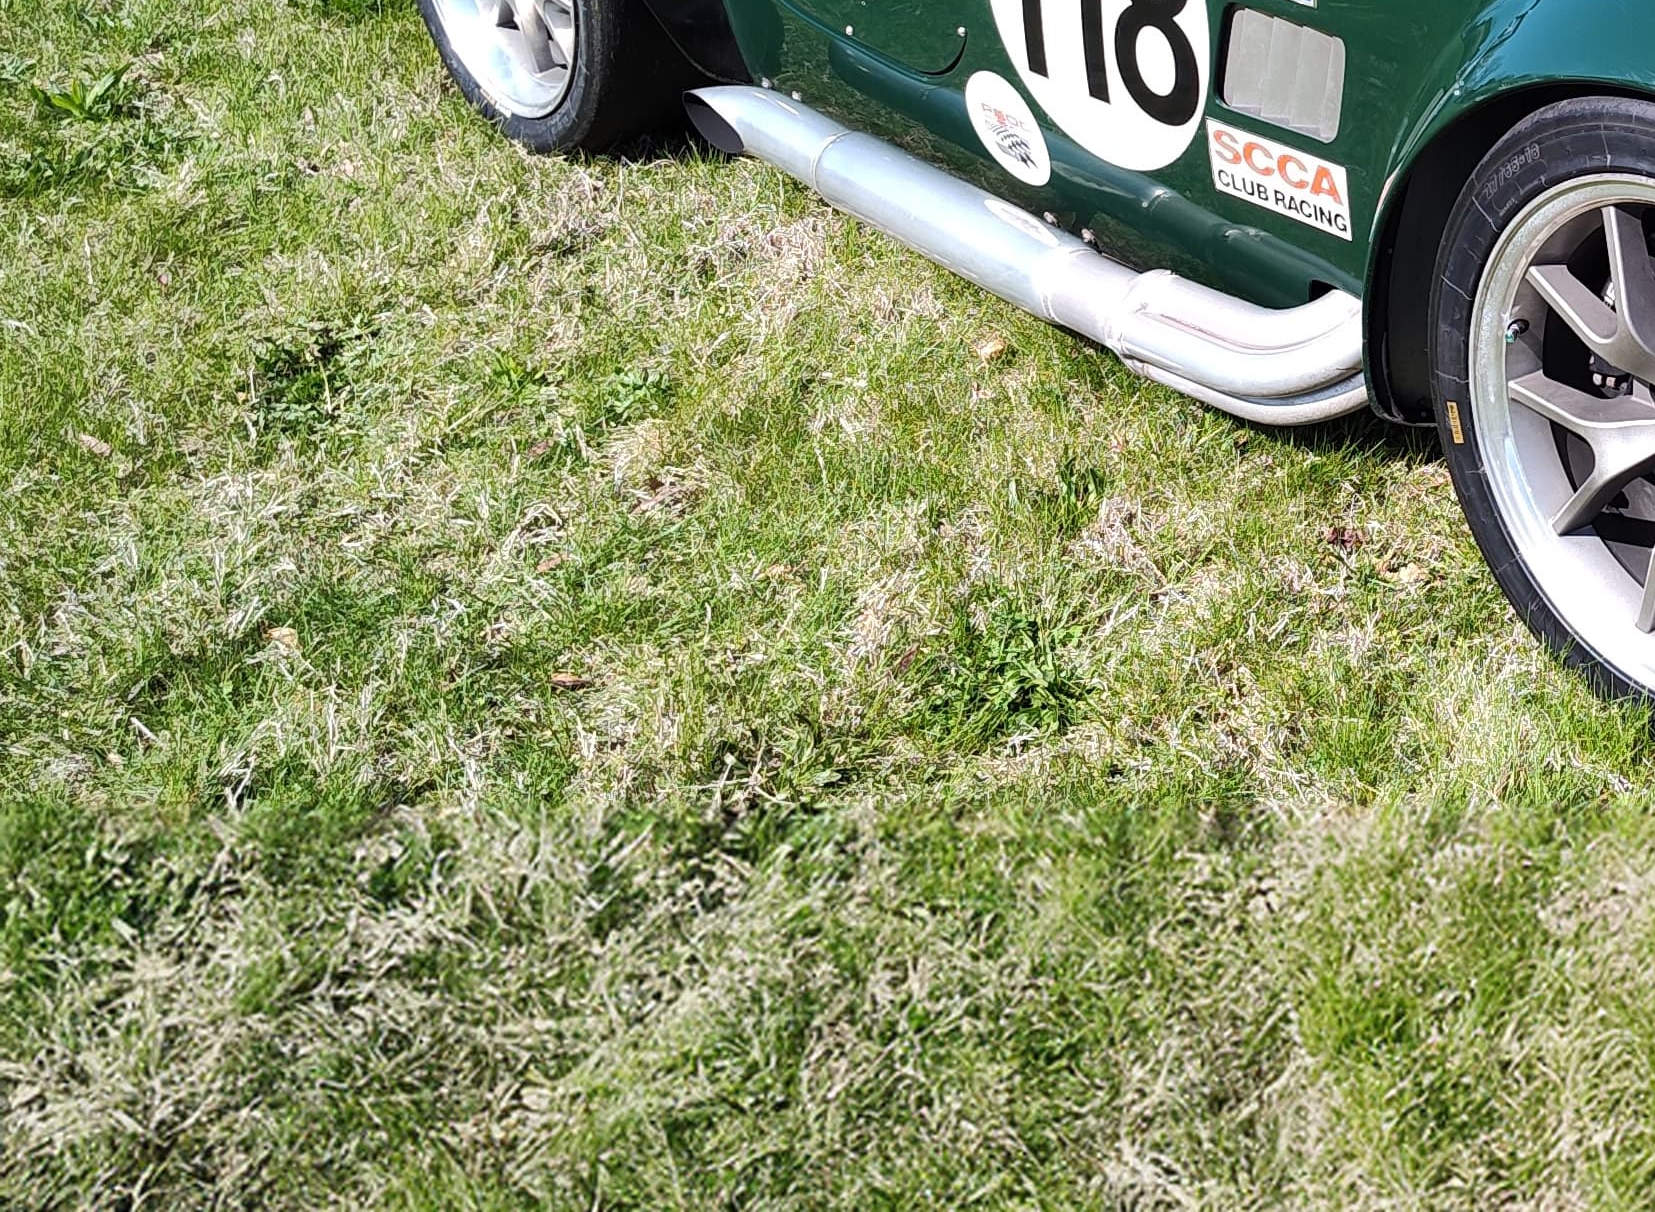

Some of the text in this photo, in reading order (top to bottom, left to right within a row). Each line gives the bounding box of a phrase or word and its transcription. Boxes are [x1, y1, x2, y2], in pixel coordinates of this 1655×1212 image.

[1213, 129, 1344, 206] SCCA
[1218, 169, 1347, 233] CLUB RACING
